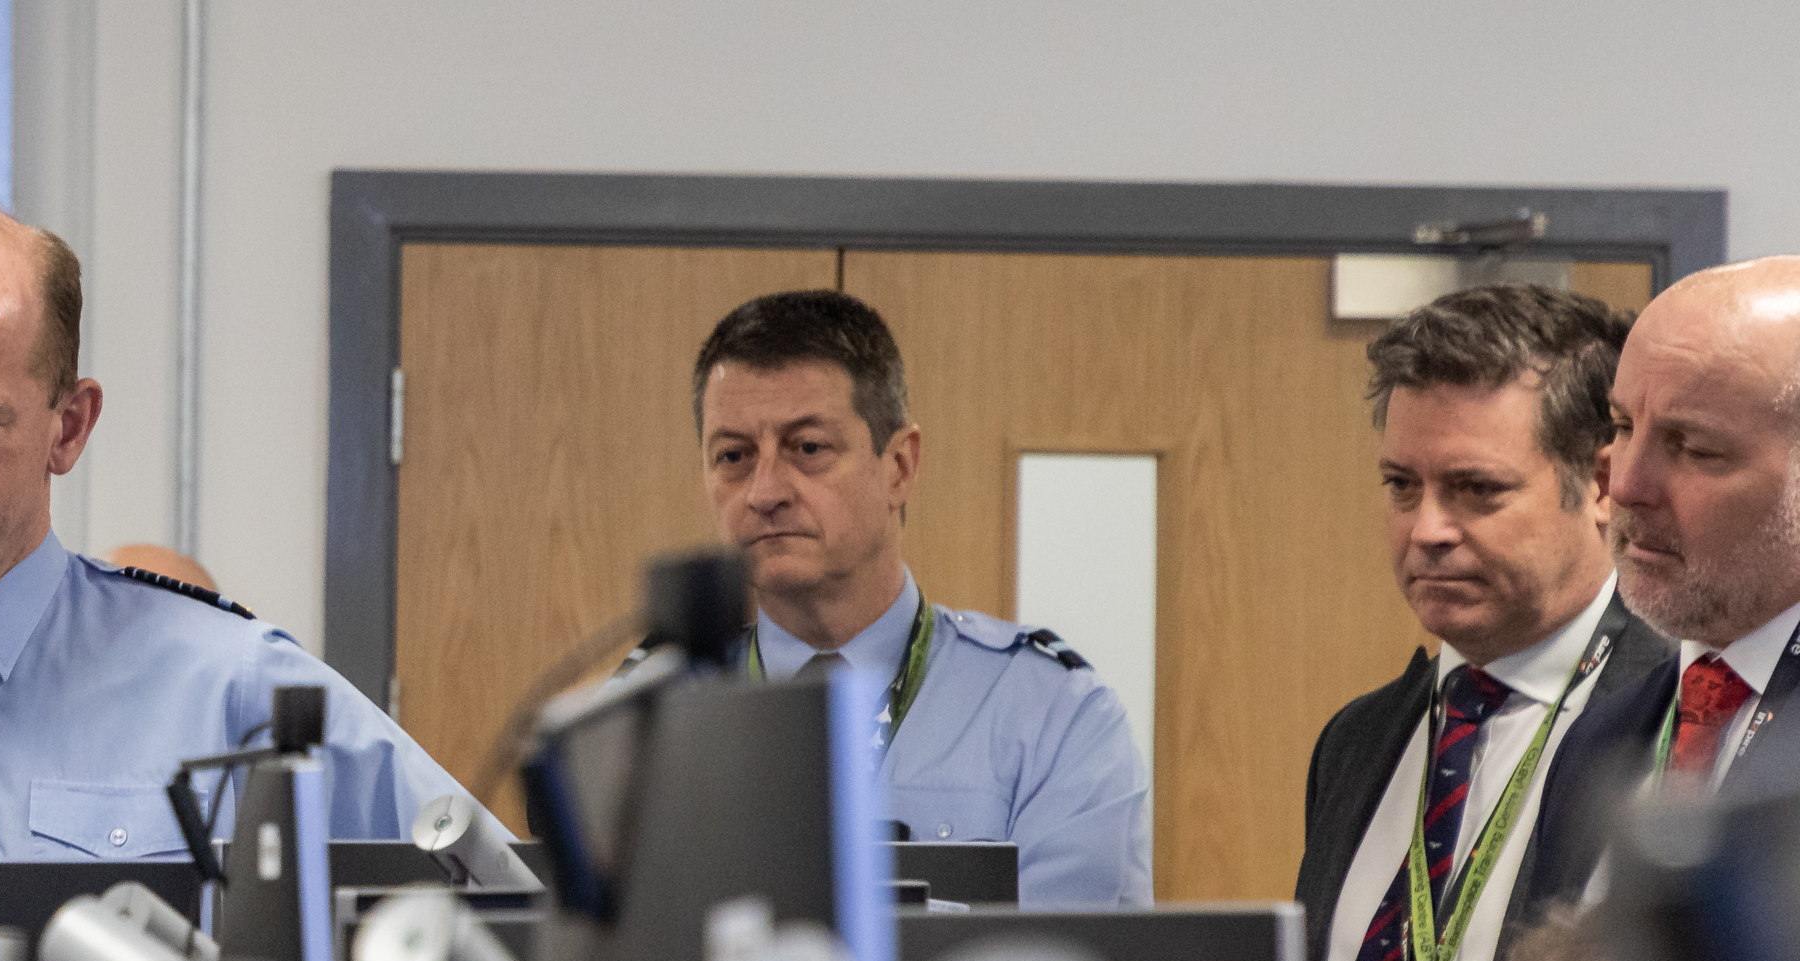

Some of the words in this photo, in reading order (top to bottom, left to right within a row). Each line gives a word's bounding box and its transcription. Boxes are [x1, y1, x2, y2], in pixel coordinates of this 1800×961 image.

[1473, 831, 1504, 876] Training
[1495, 792, 1519, 829] Centre
[1513, 747, 1541, 790] (ABTC)
[1417, 894, 1428, 929] Centre
